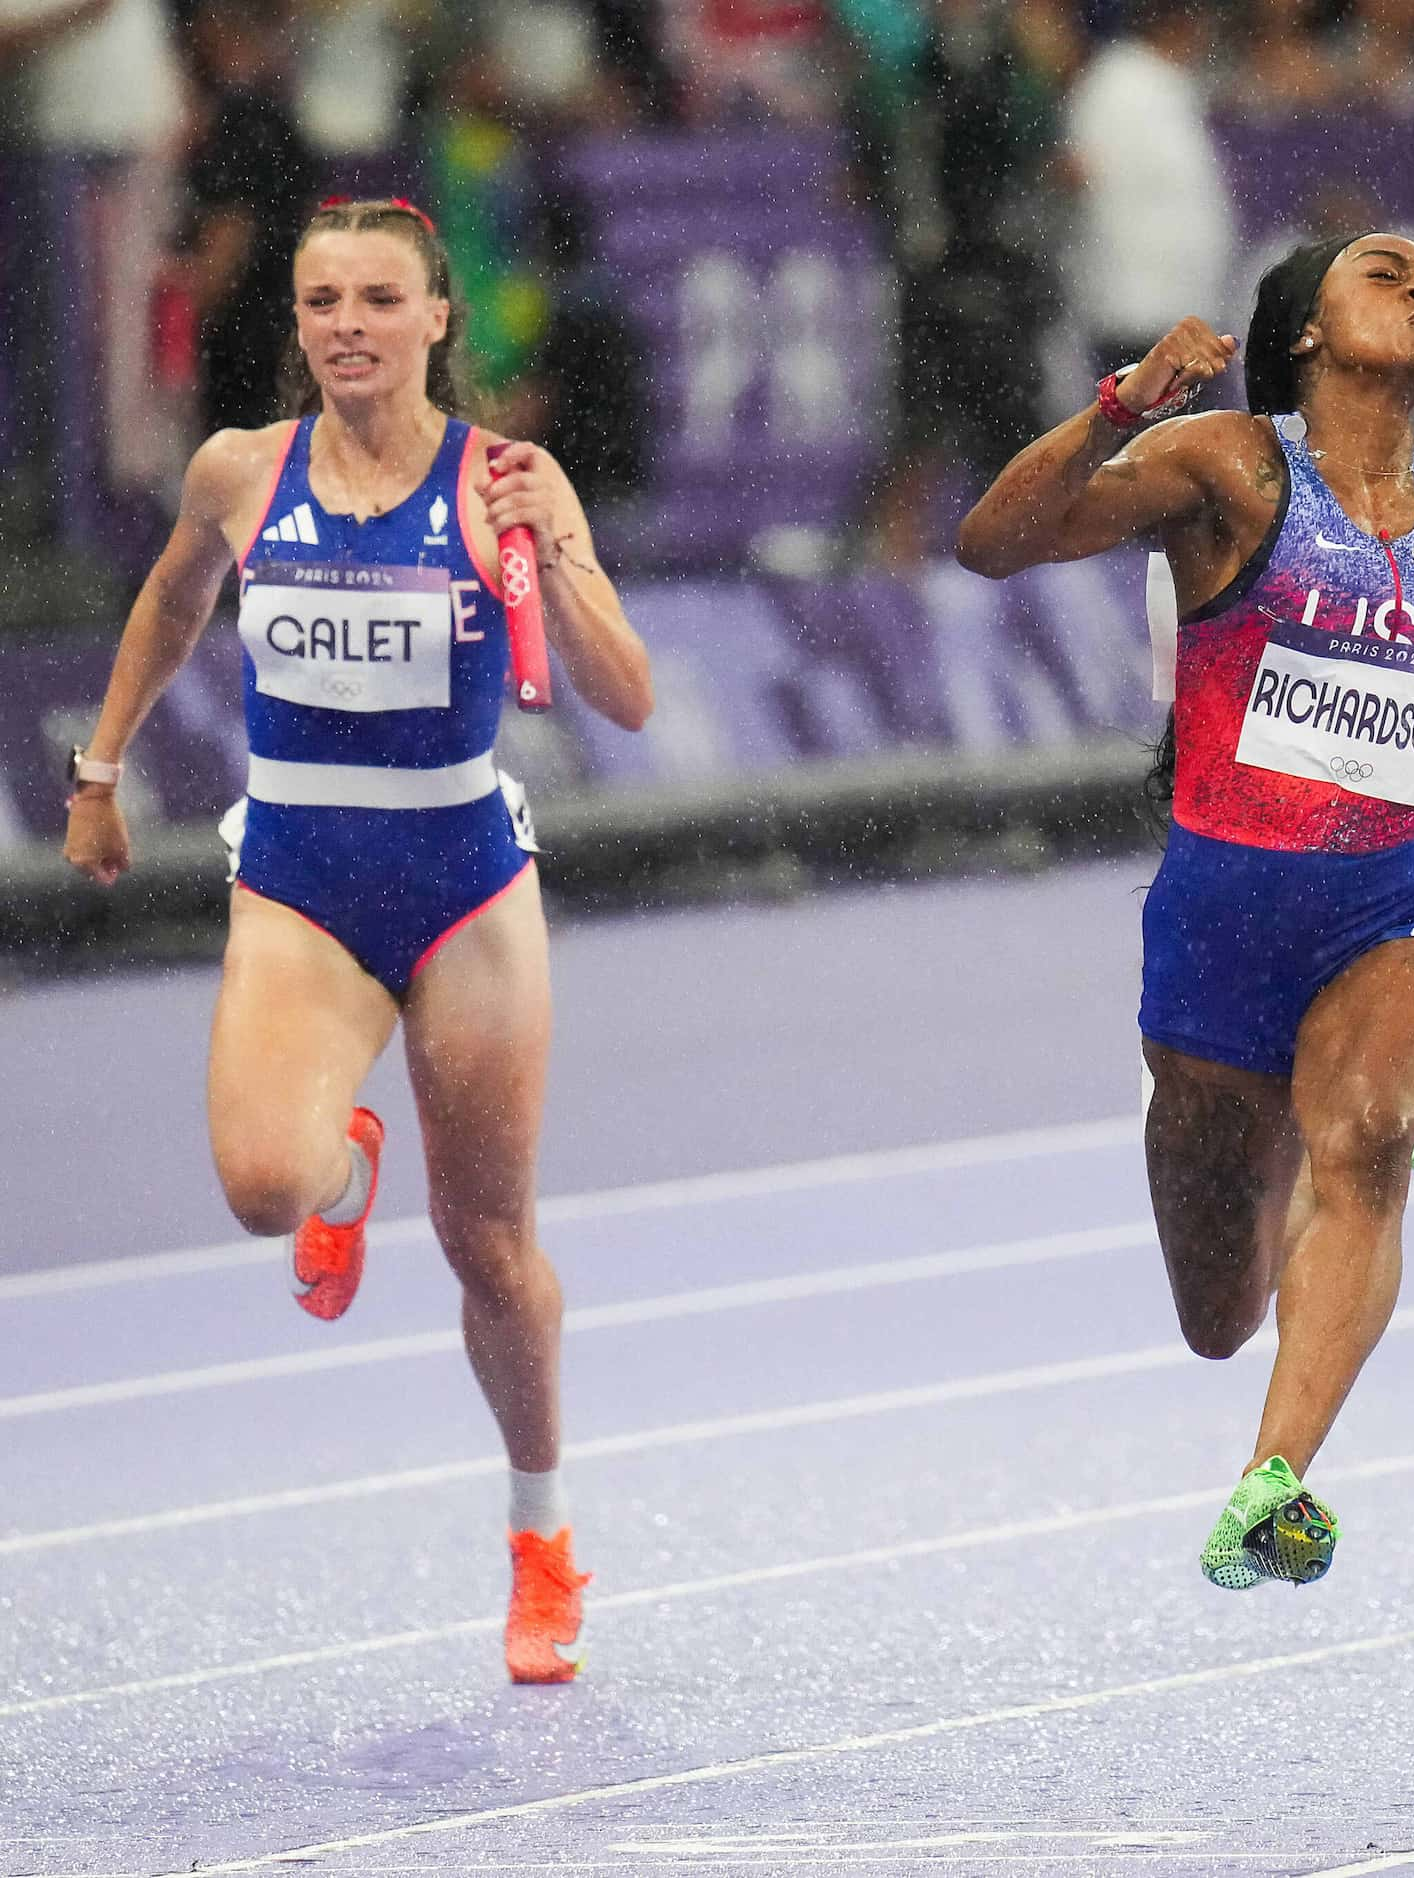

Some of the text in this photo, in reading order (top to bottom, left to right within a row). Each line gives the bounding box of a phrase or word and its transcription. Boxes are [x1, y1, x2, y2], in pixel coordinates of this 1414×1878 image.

[294, 567, 395, 586] PARIS 2024
[266, 614, 422, 662] GALET
[1328, 639, 1378, 658] PARIS
[520, 679, 537, 700] 6
